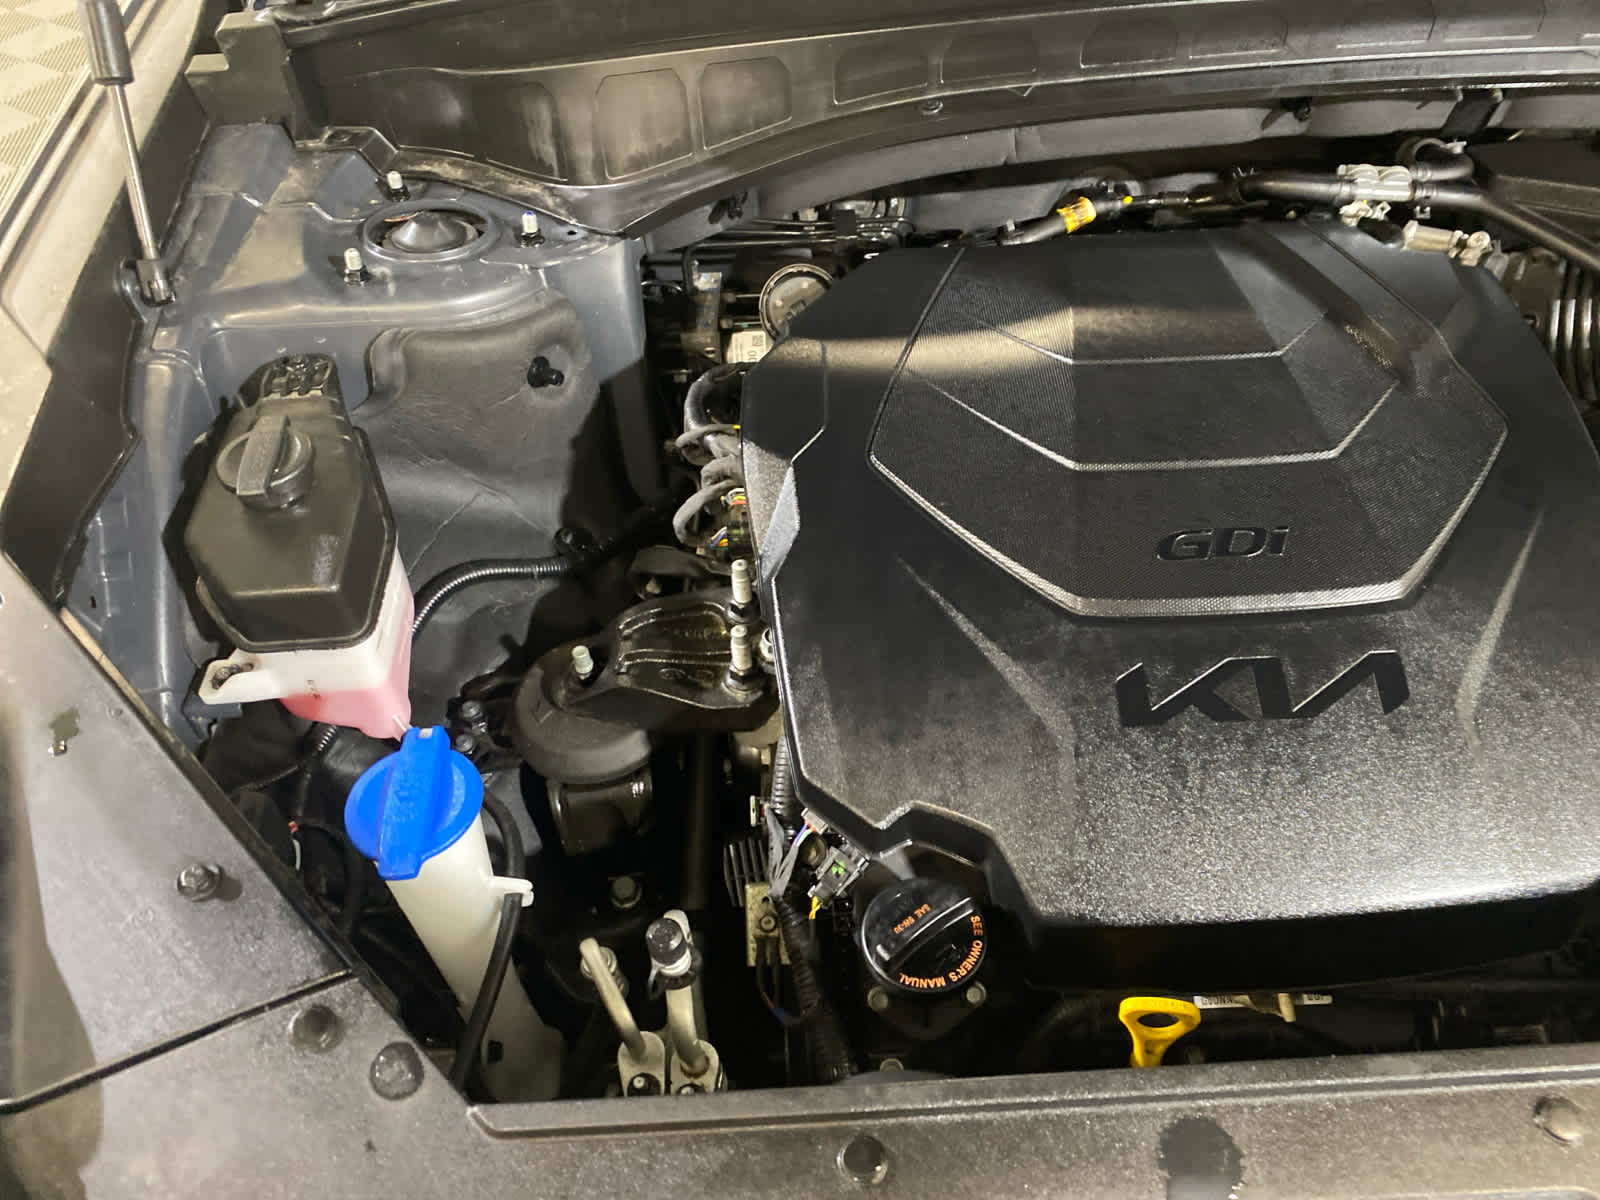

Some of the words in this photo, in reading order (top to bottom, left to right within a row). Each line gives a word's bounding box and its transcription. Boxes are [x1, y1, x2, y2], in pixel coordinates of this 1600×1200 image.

[1157, 526, 1290, 561] GDi
[1115, 649, 1411, 727] KIA
[914, 903, 931, 919] SAE
[970, 915, 983, 937] SEE
[948, 940, 983, 982] OWNER'S
[899, 973, 947, 989] MANUAL
